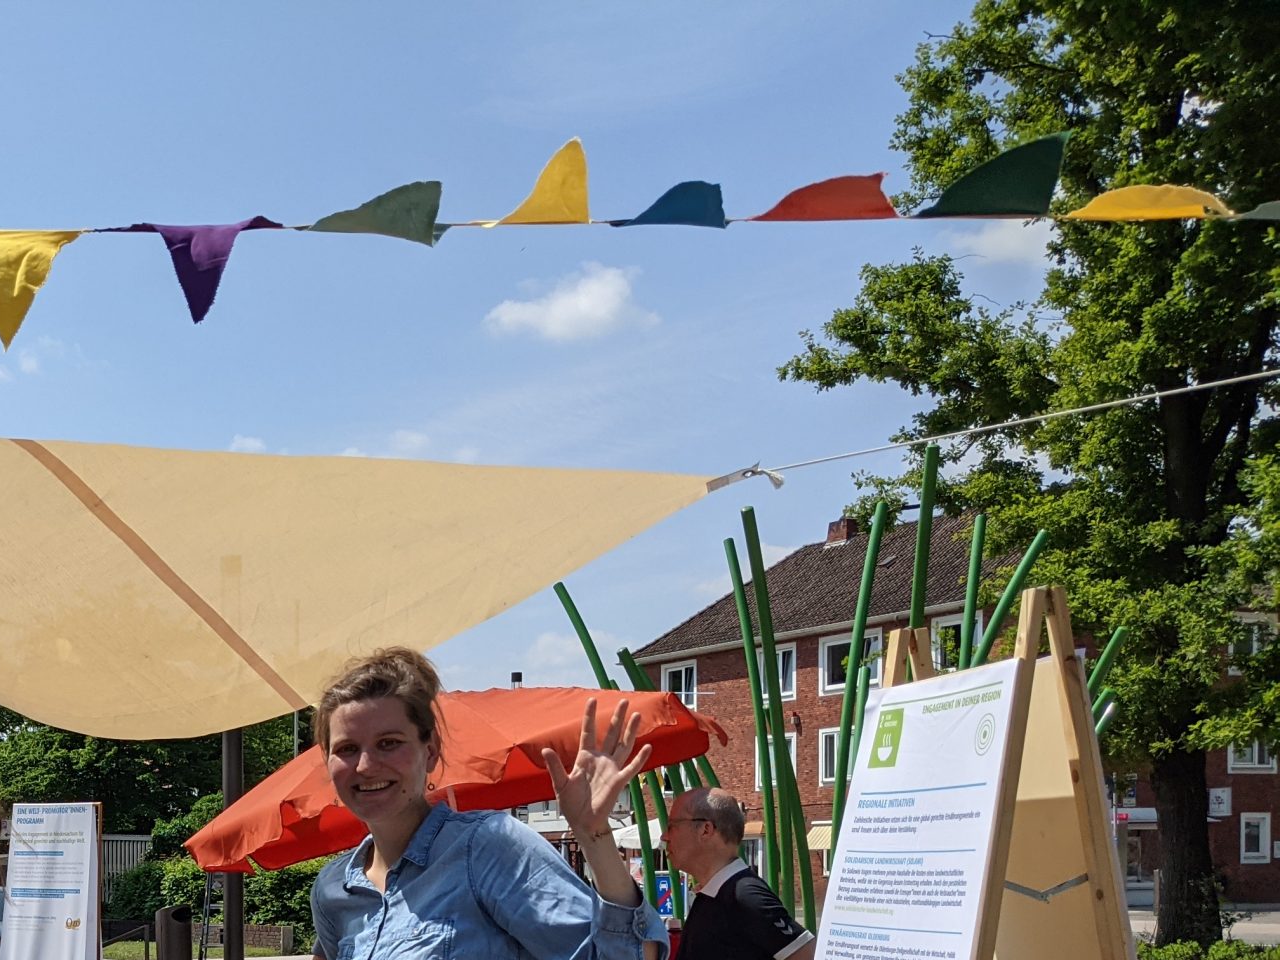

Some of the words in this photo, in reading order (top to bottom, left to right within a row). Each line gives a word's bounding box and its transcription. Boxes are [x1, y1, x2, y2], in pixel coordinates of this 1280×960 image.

[922, 700, 954, 714] ENGAGEMENT
[955, 698, 961, 708] IN
[962, 695, 980, 707] DEINER
[981, 690, 1002, 704] REGION
[857, 799, 887, 808] REGIONALE
[888, 798, 915, 808] INITIATIVEN
[845, 856, 874, 864] SOLIDARISCHE
[829, 928, 867, 939] ERNÄHRUNGSRAT
[868, 933, 890, 941] OLDENBURG
